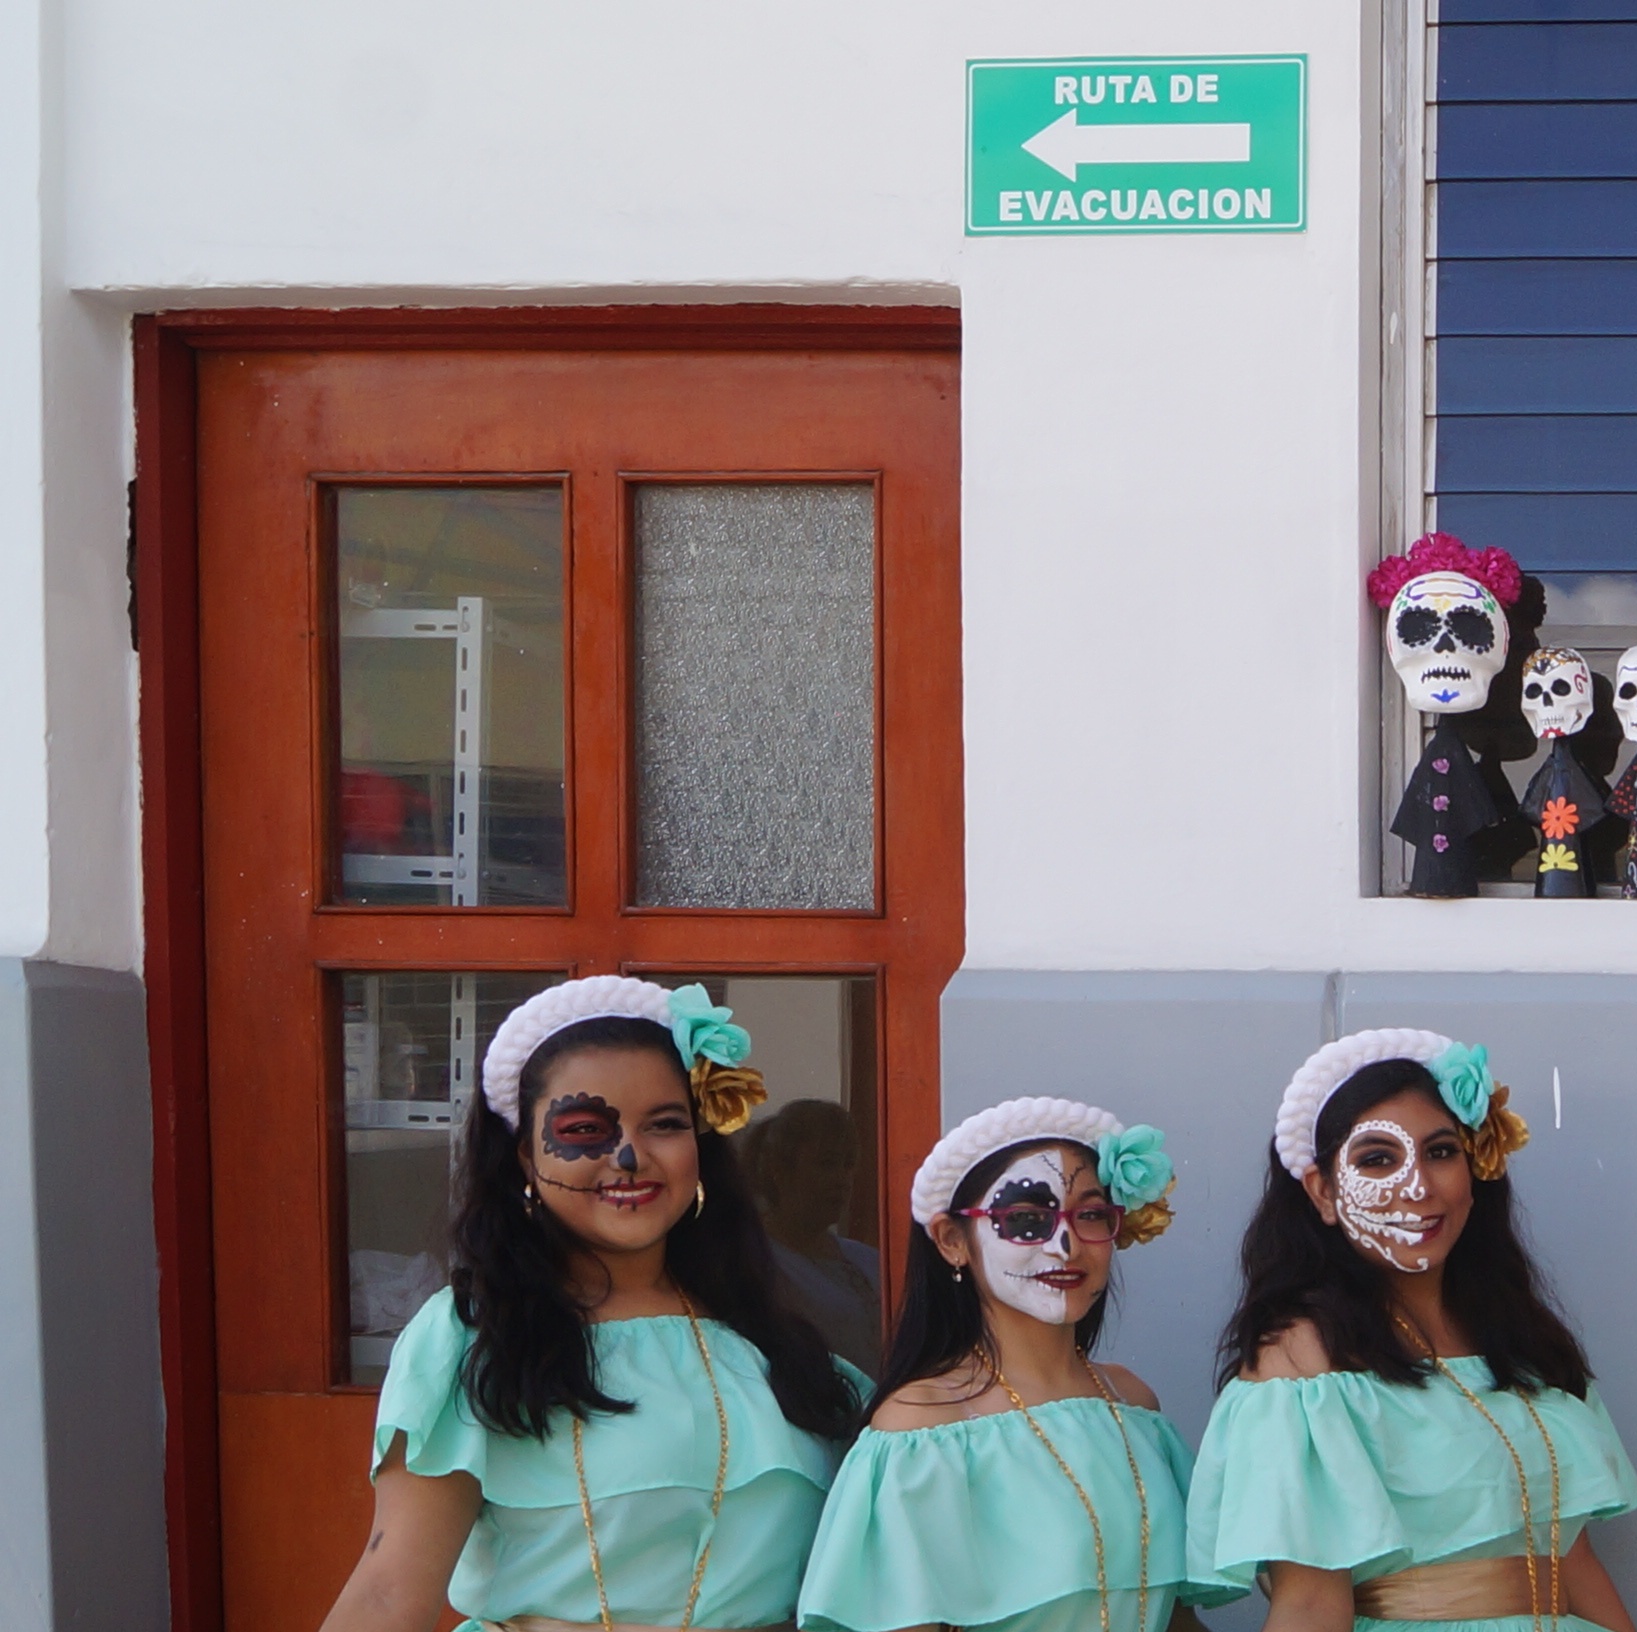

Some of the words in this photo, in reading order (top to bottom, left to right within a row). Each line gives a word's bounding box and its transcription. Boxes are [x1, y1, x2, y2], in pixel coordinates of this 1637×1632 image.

[1054, 75, 1157, 104] RUTA
[1170, 74, 1219, 103] DE
[999, 189, 1271, 221] EVACUACION
